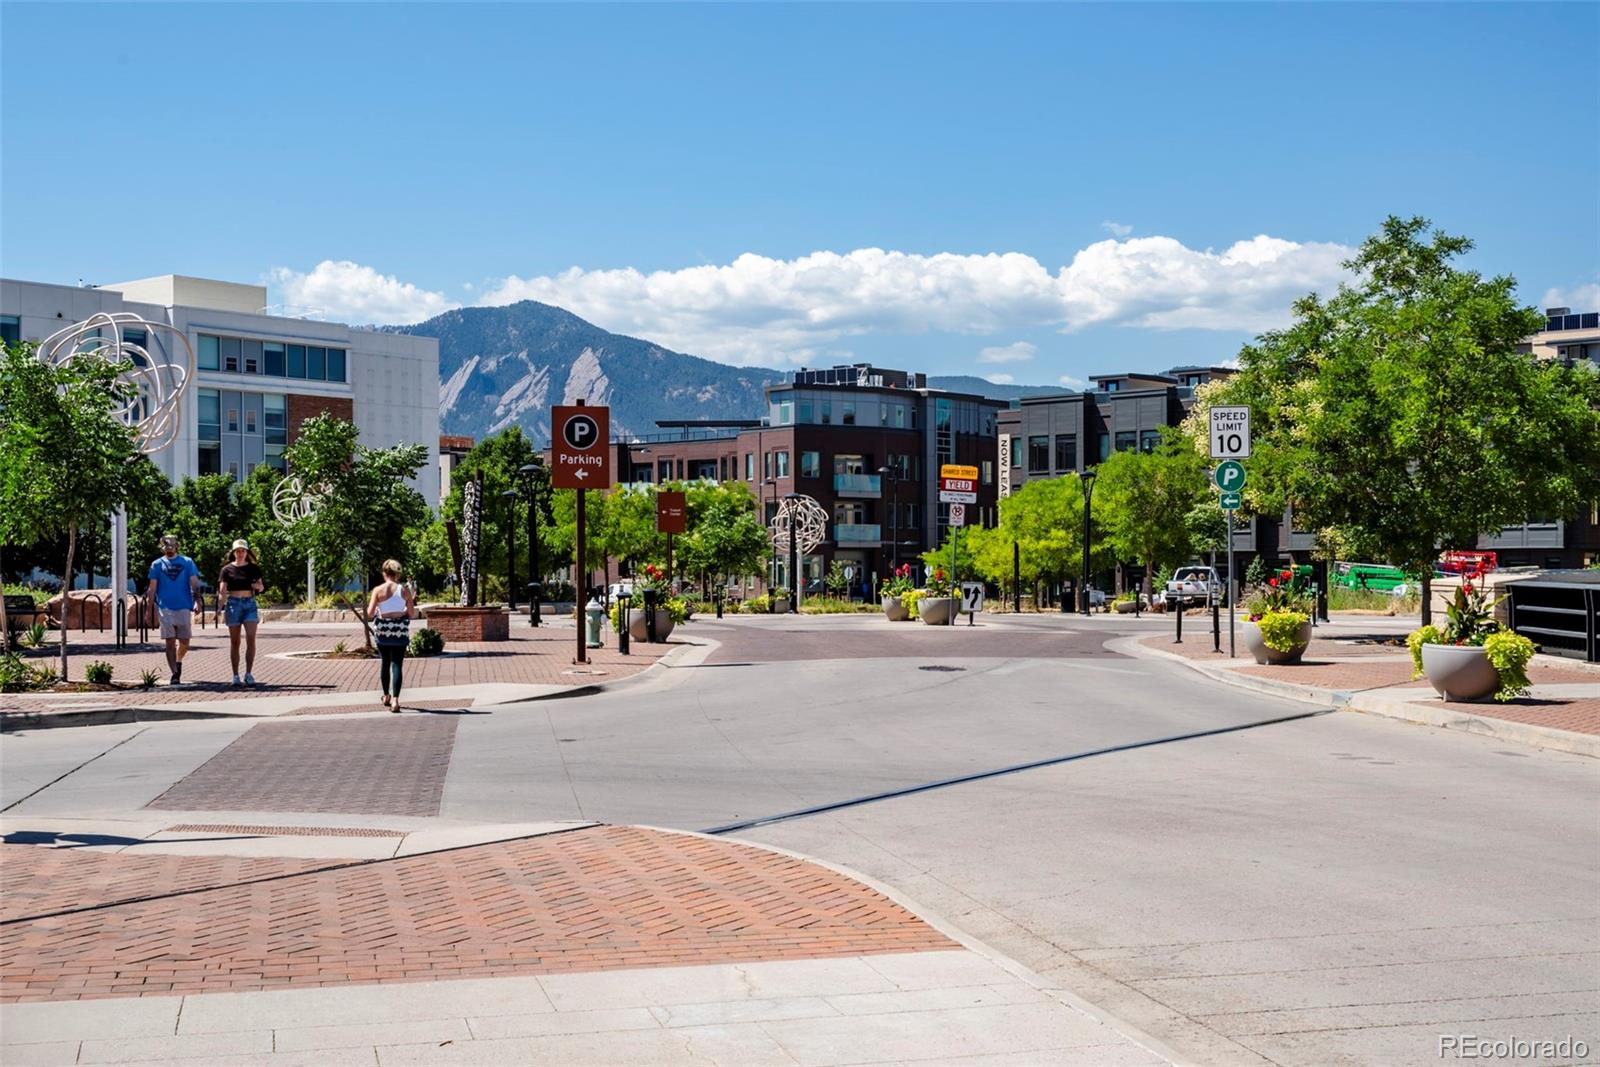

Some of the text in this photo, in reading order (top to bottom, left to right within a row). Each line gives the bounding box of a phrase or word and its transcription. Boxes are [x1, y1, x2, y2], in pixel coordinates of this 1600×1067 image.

[1213, 412, 1247, 421] SPEED
[574, 422, 590, 442] P
[1216, 422, 1243, 431] LIMIT
[1218, 434, 1242, 453] 10
[560, 454, 603, 467] Parking
[1223, 468, 1239, 486] P
[948, 480, 970, 490] YIELD
